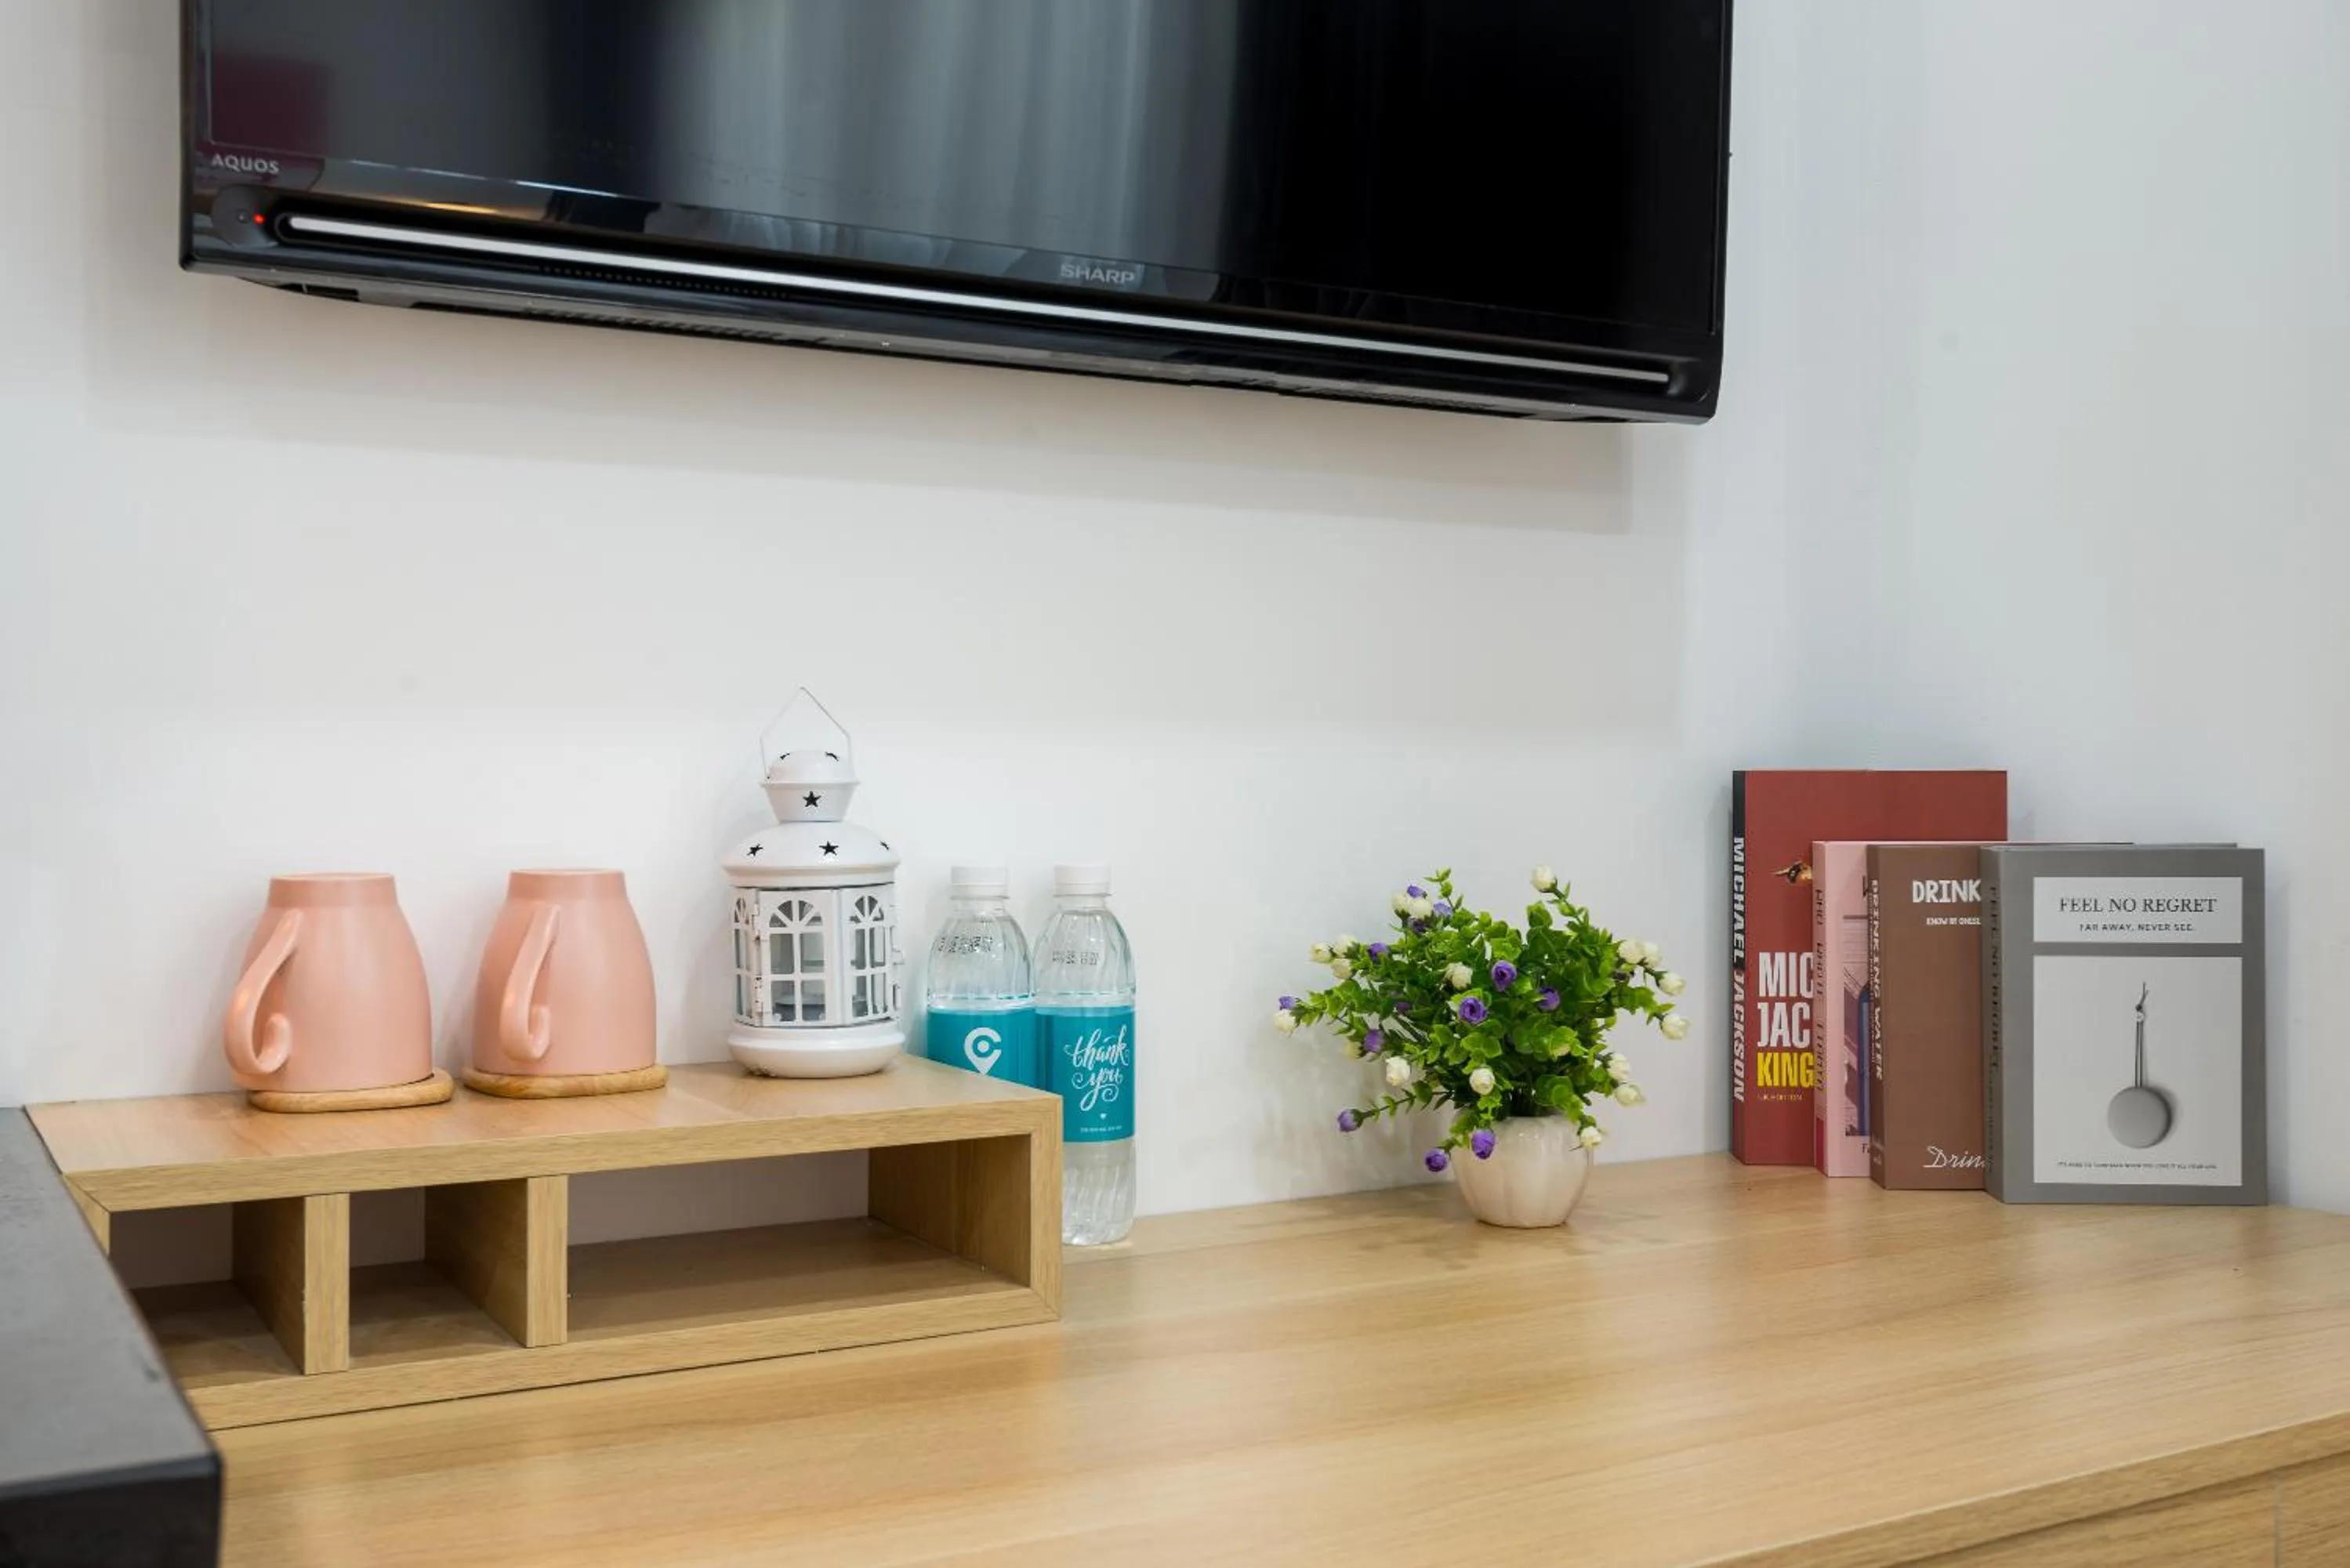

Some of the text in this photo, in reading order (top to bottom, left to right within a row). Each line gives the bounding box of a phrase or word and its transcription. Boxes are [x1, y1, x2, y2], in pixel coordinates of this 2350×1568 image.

[211, 154, 279, 174] AQUOS
[1061, 264, 1135, 284] SHARP
[1913, 878, 1982, 903] DRINK
[2059, 897, 2218, 913] FEEL NO REGRET
[2138, 923, 2171, 932] NEVER
[1733, 837, 1745, 1103] MICHAEL JACKSON
[1063, 1024, 1130, 1070] thank
[1757, 1052, 1815, 1088] KING
[1072, 1067, 1124, 1112] you
